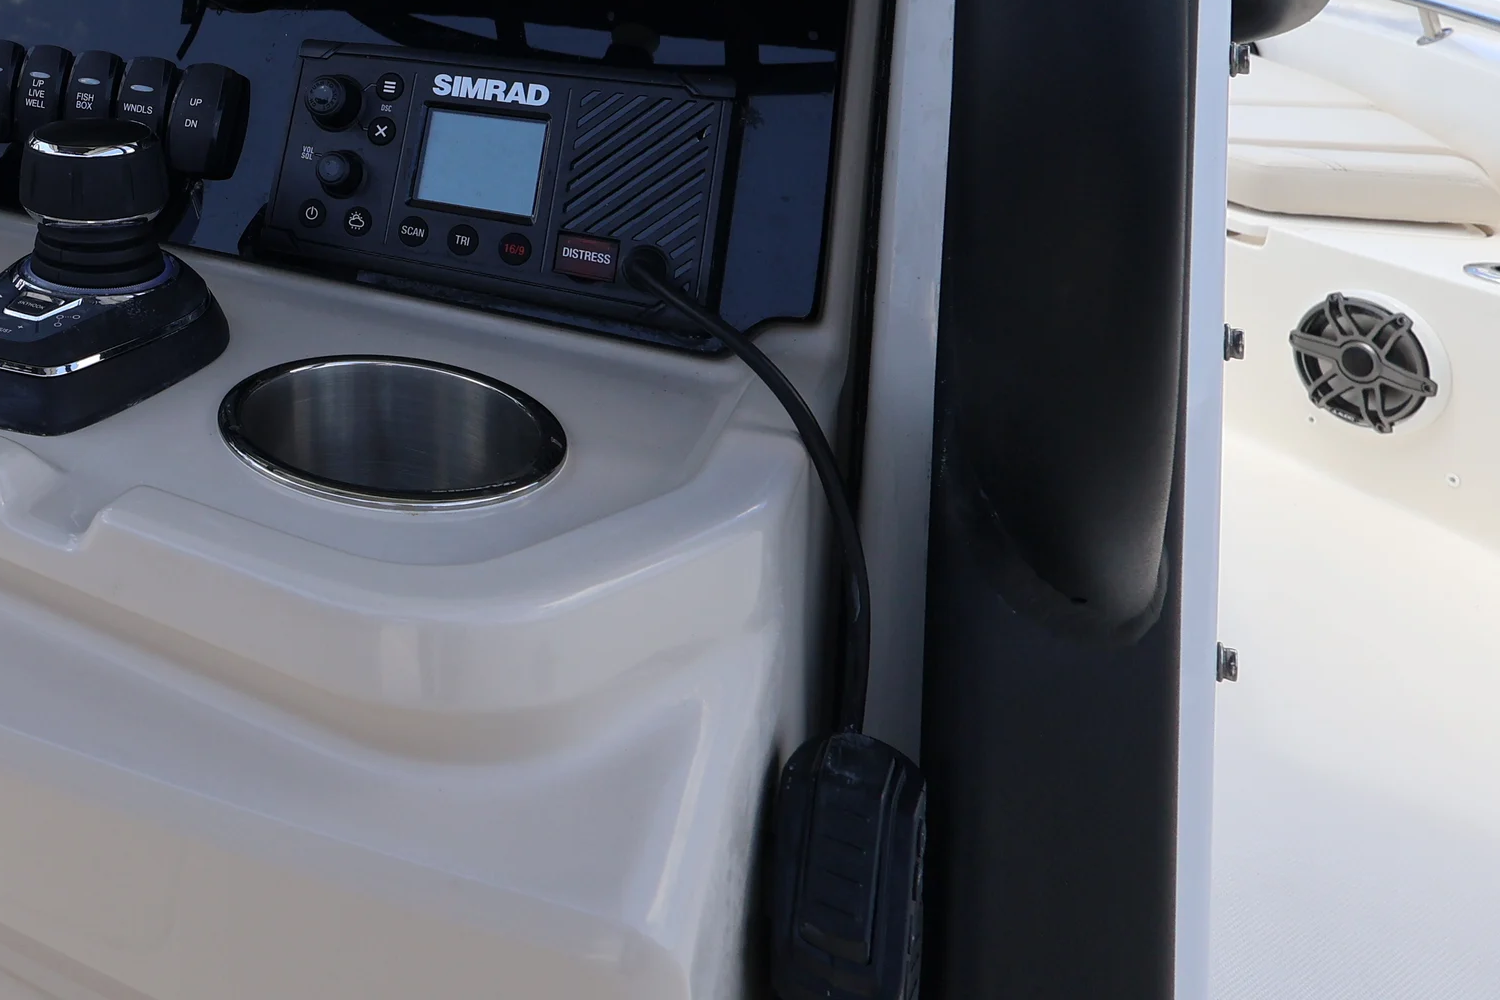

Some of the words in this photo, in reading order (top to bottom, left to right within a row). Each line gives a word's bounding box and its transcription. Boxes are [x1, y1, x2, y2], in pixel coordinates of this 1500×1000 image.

[32, 78, 45, 87] L/P
[28, 88, 45, 99] LIVE
[432, 73, 550, 106] SIMRAD
[76, 92, 95, 102] FISH
[25, 98, 46, 109] WELL
[75, 100, 93, 110] BOX
[189, 98, 203, 107] UP
[123, 102, 153, 115] WNDLS
[381, 104, 392, 112] DSC
[184, 118, 198, 128] DN
[303, 146, 314, 154] VOL
[301, 152, 313, 161] SQL
[400, 225, 425, 238] SCAN
[455, 234, 471, 246] TRI
[504, 243, 525, 256] 16/9
[562, 246, 611, 265] DISTRESS
